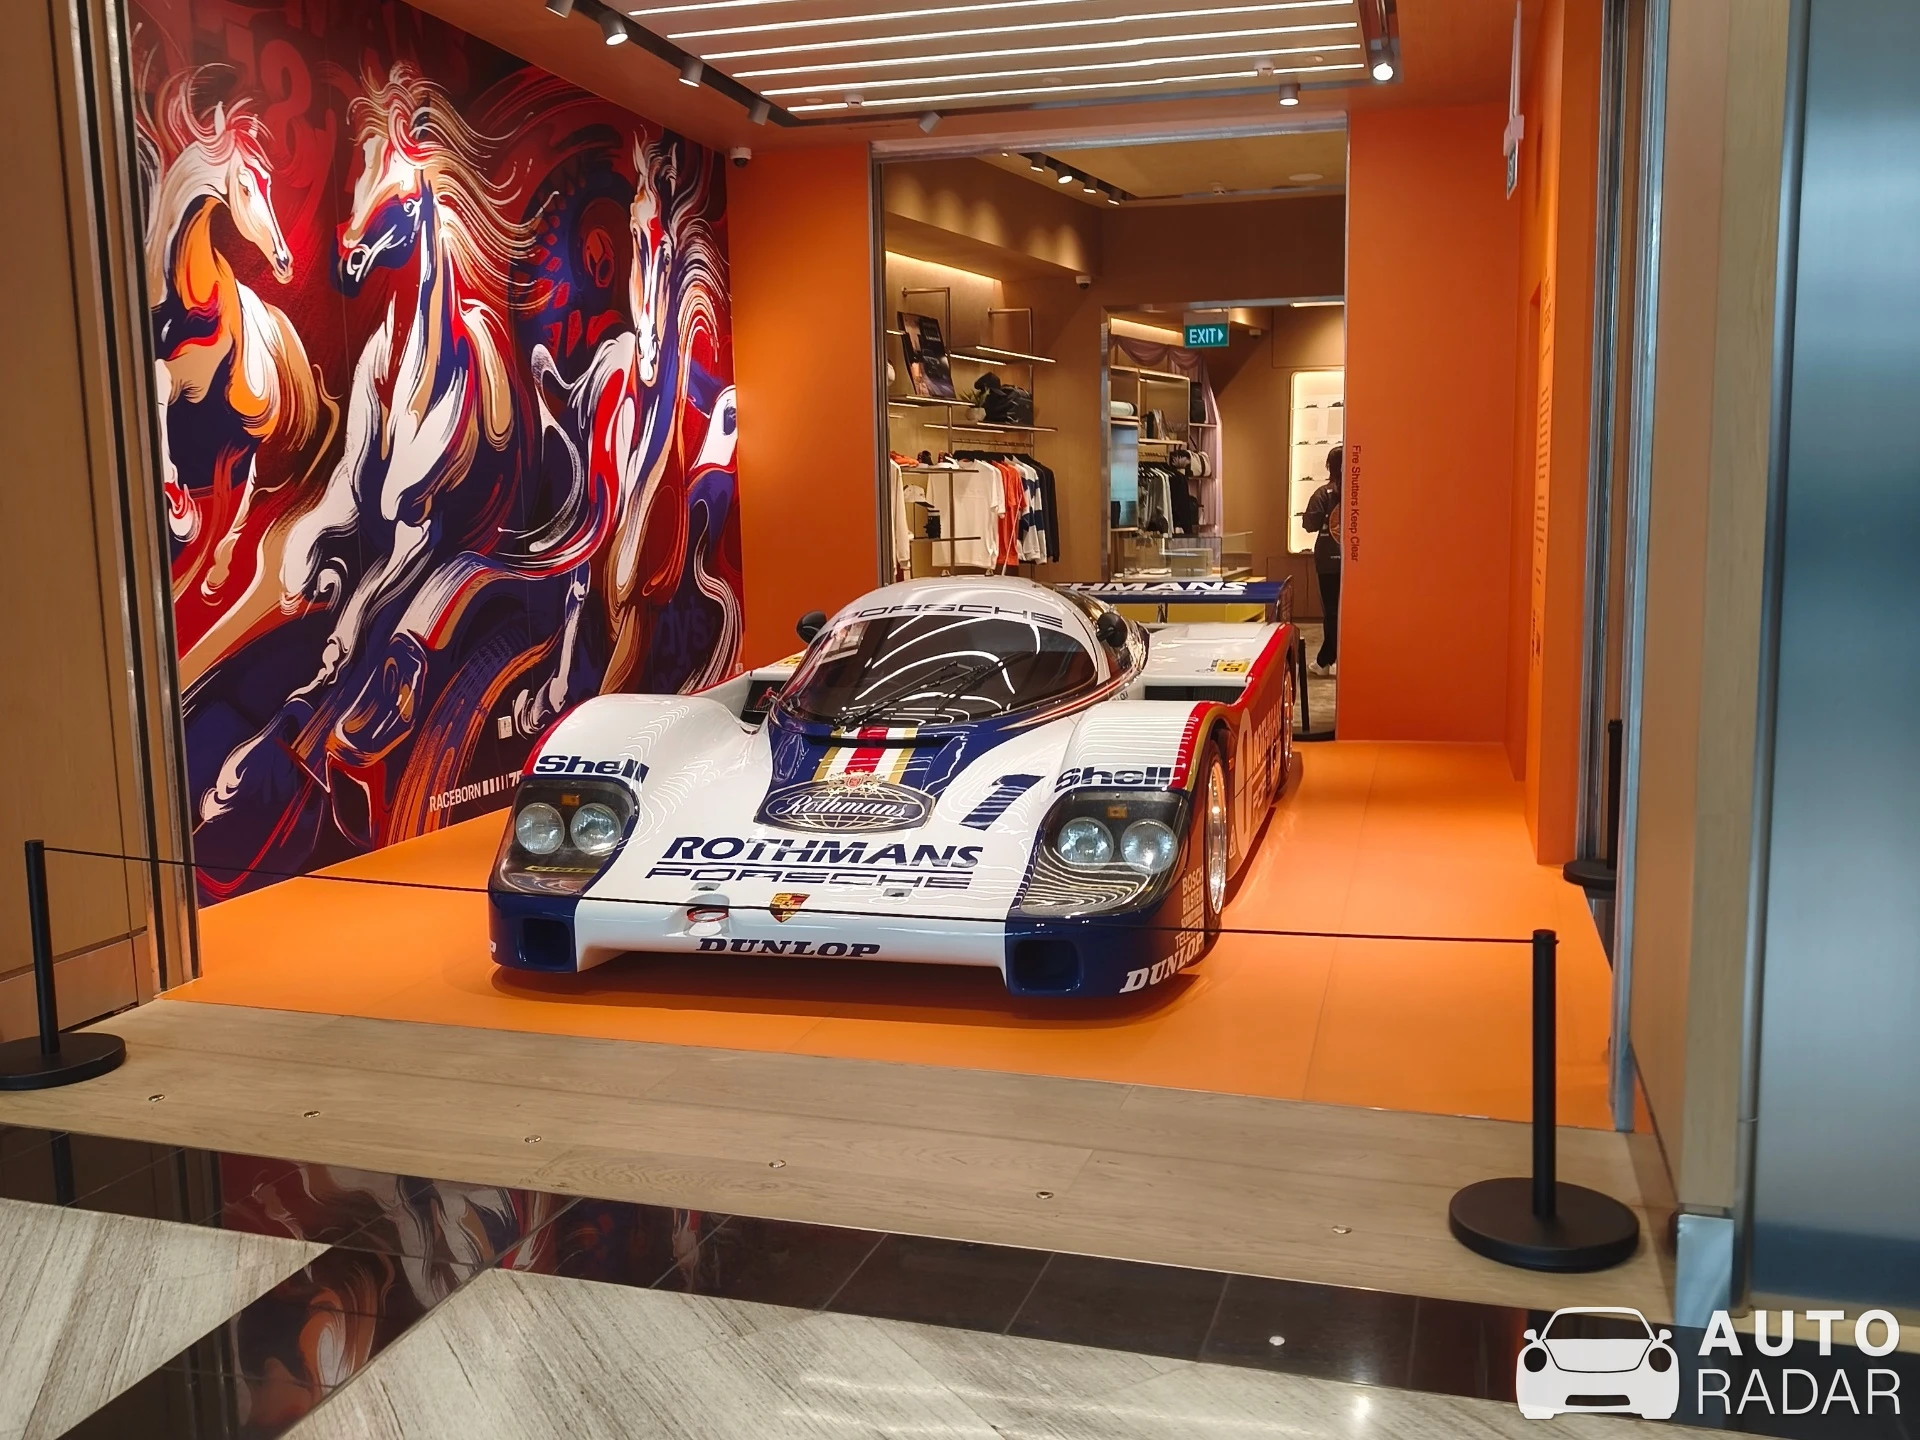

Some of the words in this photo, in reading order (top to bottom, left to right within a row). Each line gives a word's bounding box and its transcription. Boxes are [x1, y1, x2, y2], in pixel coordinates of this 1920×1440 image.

[1189, 327, 1217, 344] EXIT
[1352, 445, 1361, 464] Fire
[1351, 466, 1361, 506] Shutters
[1349, 508, 1360, 534] Keep
[1350, 536, 1359, 562] Clear
[1056, 582, 1248, 592] HMANS
[834, 603, 1063, 629] PORSCHE
[535, 755, 650, 785] Shell
[1054, 766, 1173, 793] Shell
[429, 782, 482, 813] RACEBORN
[775, 795, 907, 817] Rothmans
[959, 773, 1046, 832] 1
[661, 836, 984, 868] ROTHMANS
[644, 867, 974, 890] PORSCHE
[1182, 865, 1204, 897] BOSCH
[695, 937, 881, 958] DUNLOP
[1118, 933, 1205, 994] DUNLOP
